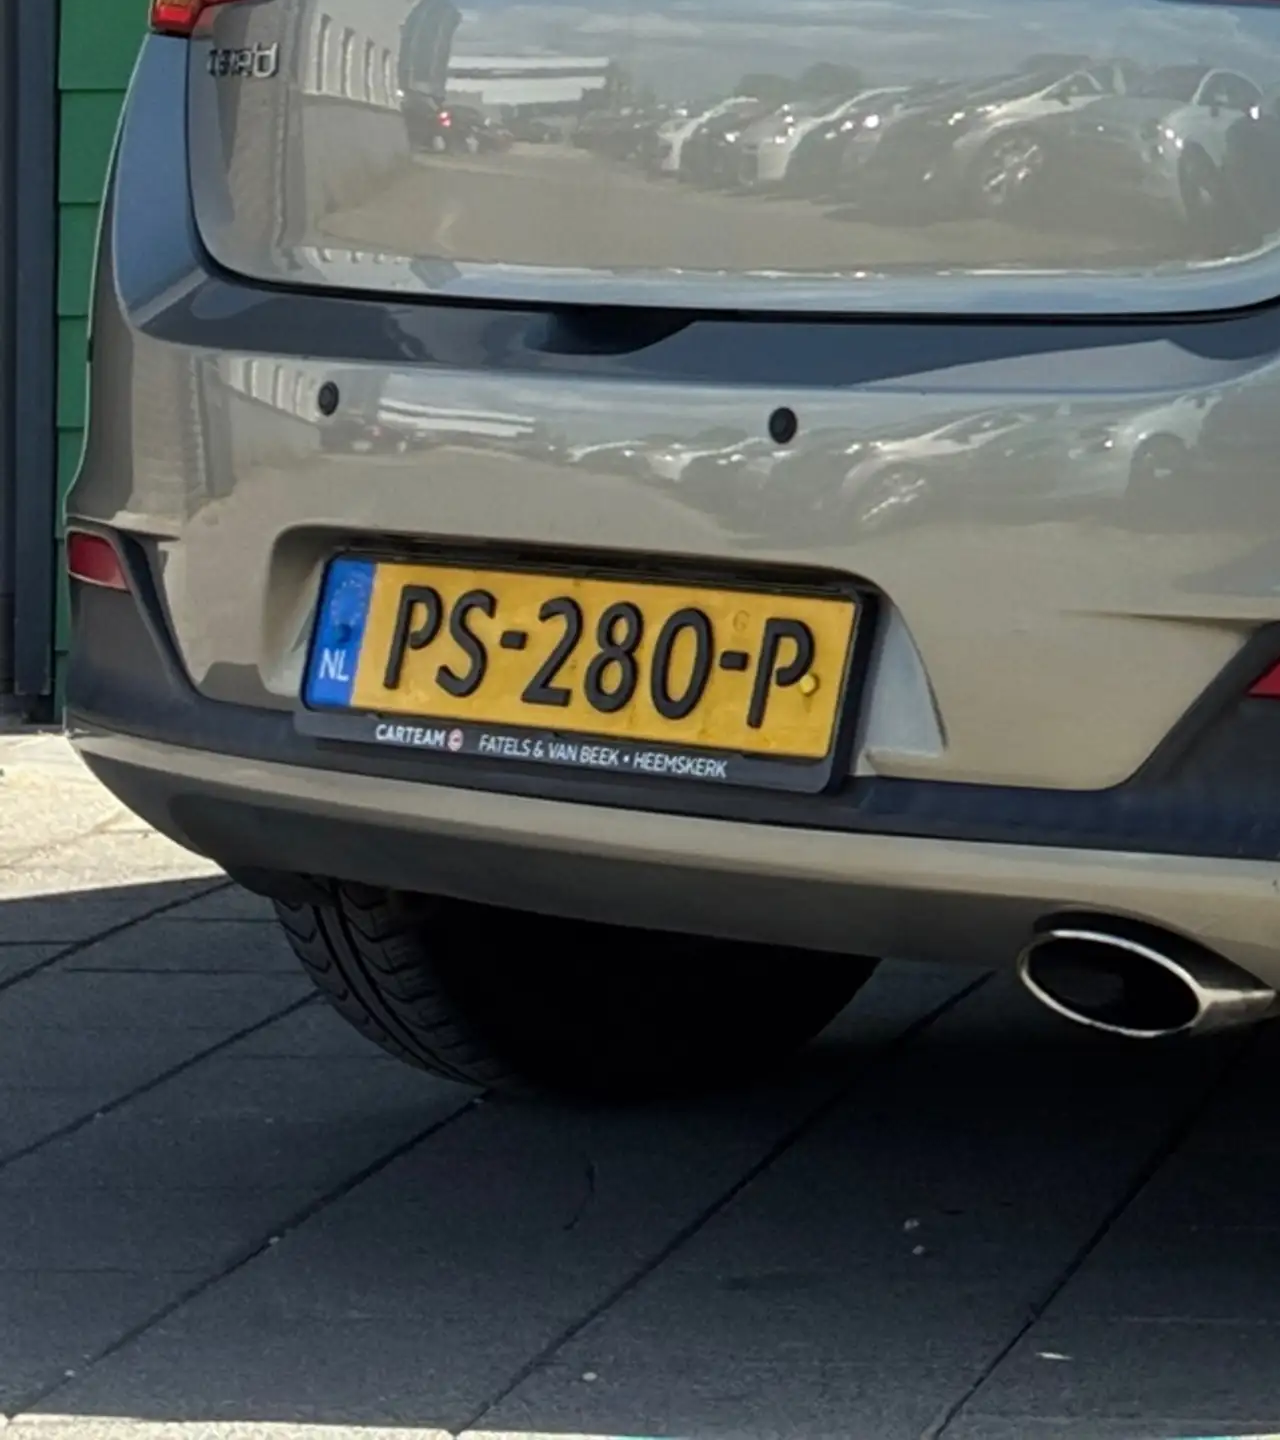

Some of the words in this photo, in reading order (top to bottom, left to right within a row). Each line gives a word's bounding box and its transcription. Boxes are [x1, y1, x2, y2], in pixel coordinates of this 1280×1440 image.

[318, 647, 350, 683] NL
[382, 583, 816, 729] PS-280-P
[374, 723, 446, 749] CARTEAM
[478, 733, 532, 758] FATELS
[533, 739, 545, 759] &
[548, 741, 578, 763] VAN
[579, 745, 620, 766] BEEK
[632, 750, 728, 779] HEEMSKERK
